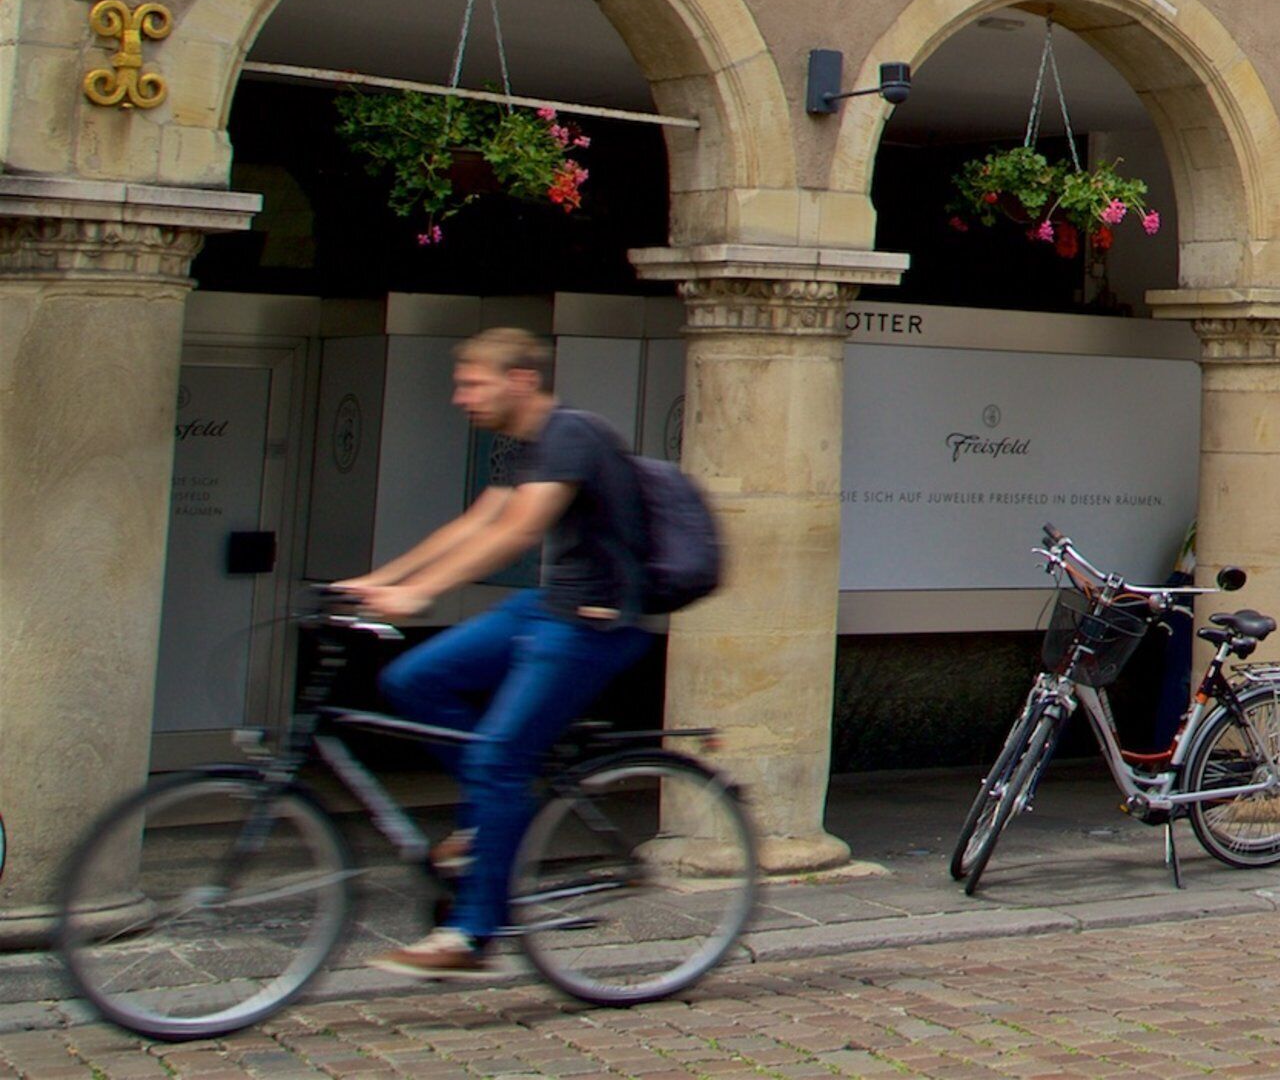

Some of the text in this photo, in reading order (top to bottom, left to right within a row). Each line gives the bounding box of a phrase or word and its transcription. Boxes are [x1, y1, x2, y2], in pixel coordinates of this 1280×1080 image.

[945, 432, 1031, 462] Freisfeld
[864, 491, 893, 503] SICH
[900, 492, 922, 503] AUF
[927, 492, 984, 504] JUWELIER
[989, 492, 1048, 505] FREISFELD
[1053, 494, 1065, 505] IN
[1071, 494, 1111, 506] DIESEN
